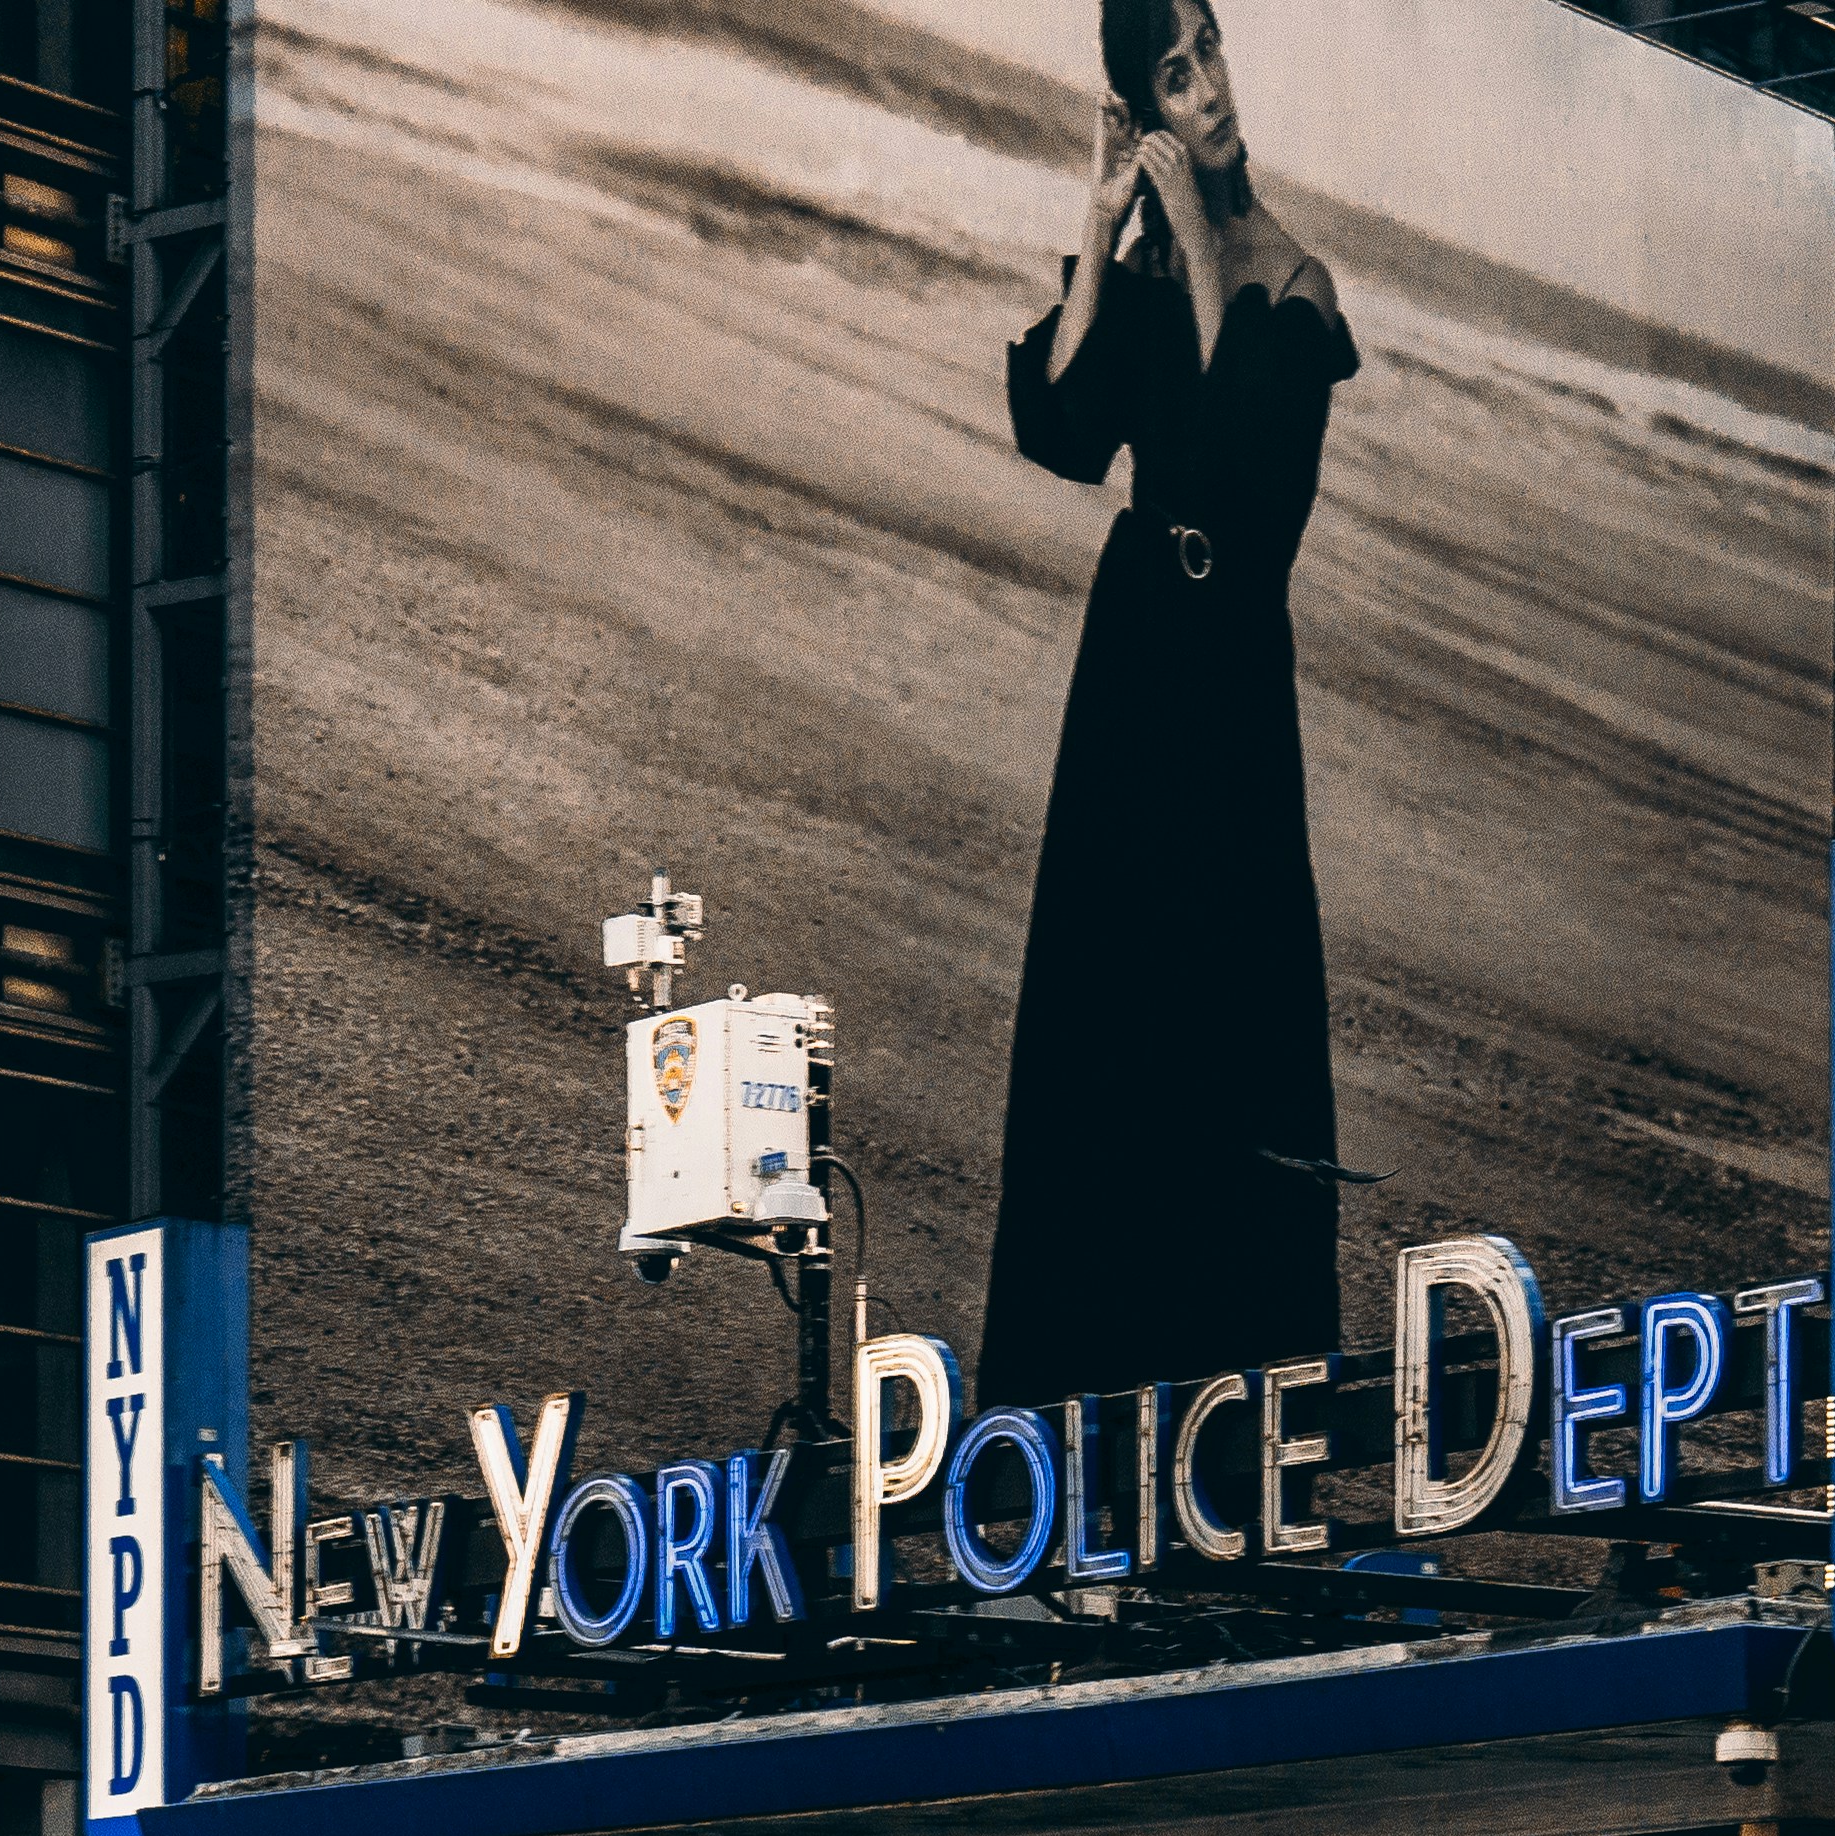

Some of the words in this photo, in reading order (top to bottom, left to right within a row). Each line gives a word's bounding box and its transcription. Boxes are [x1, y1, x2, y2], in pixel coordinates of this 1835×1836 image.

[106, 1252, 149, 1796] NYPD
[198, 1440, 450, 1696] NEW
[468, 1391, 805, 1660] YORK
[854, 1332, 1336, 1612] POLICE
[1394, 1233, 1826, 1538] DEPT
